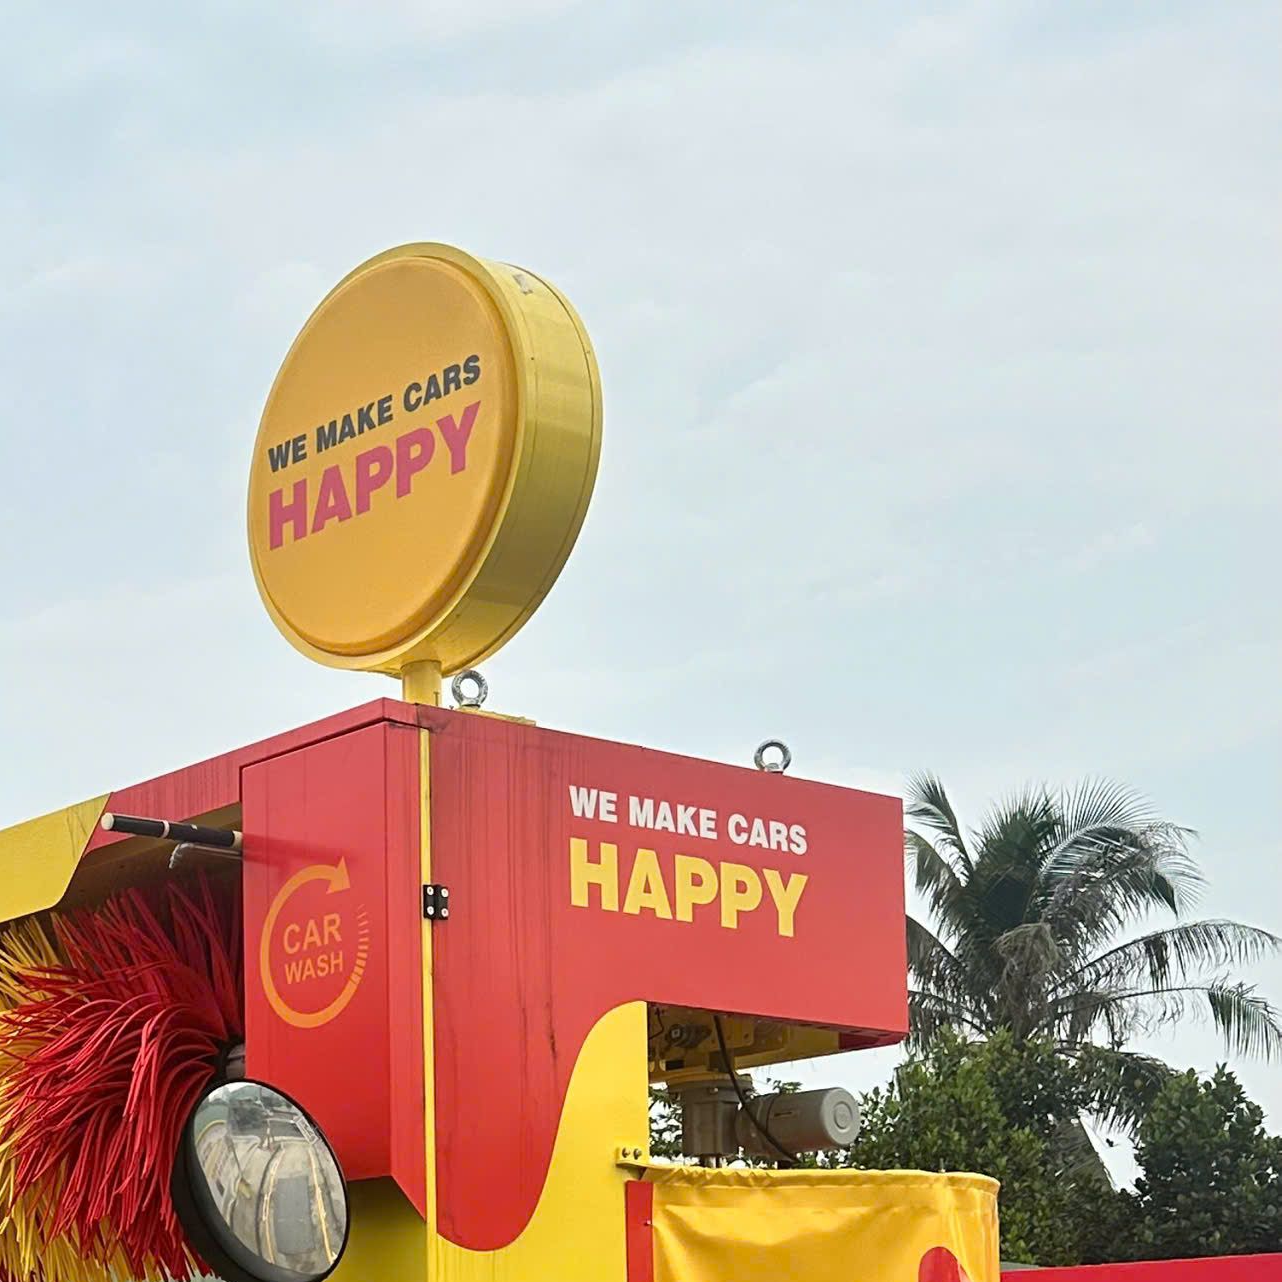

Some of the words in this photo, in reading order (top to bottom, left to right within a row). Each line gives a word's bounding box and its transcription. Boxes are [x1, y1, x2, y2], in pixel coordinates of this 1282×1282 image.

[268, 434, 307, 473] WE
[316, 395, 393, 453] MAKE
[403, 355, 480, 412] CARS
[269, 400, 481, 551] HAPPY
[569, 786, 618, 823] WE
[628, 796, 718, 840] MAKE
[728, 815, 808, 856] CARS
[569, 838, 808, 938] HAPPY
[283, 912, 341, 956] CAR
[284, 950, 344, 986] WASH
